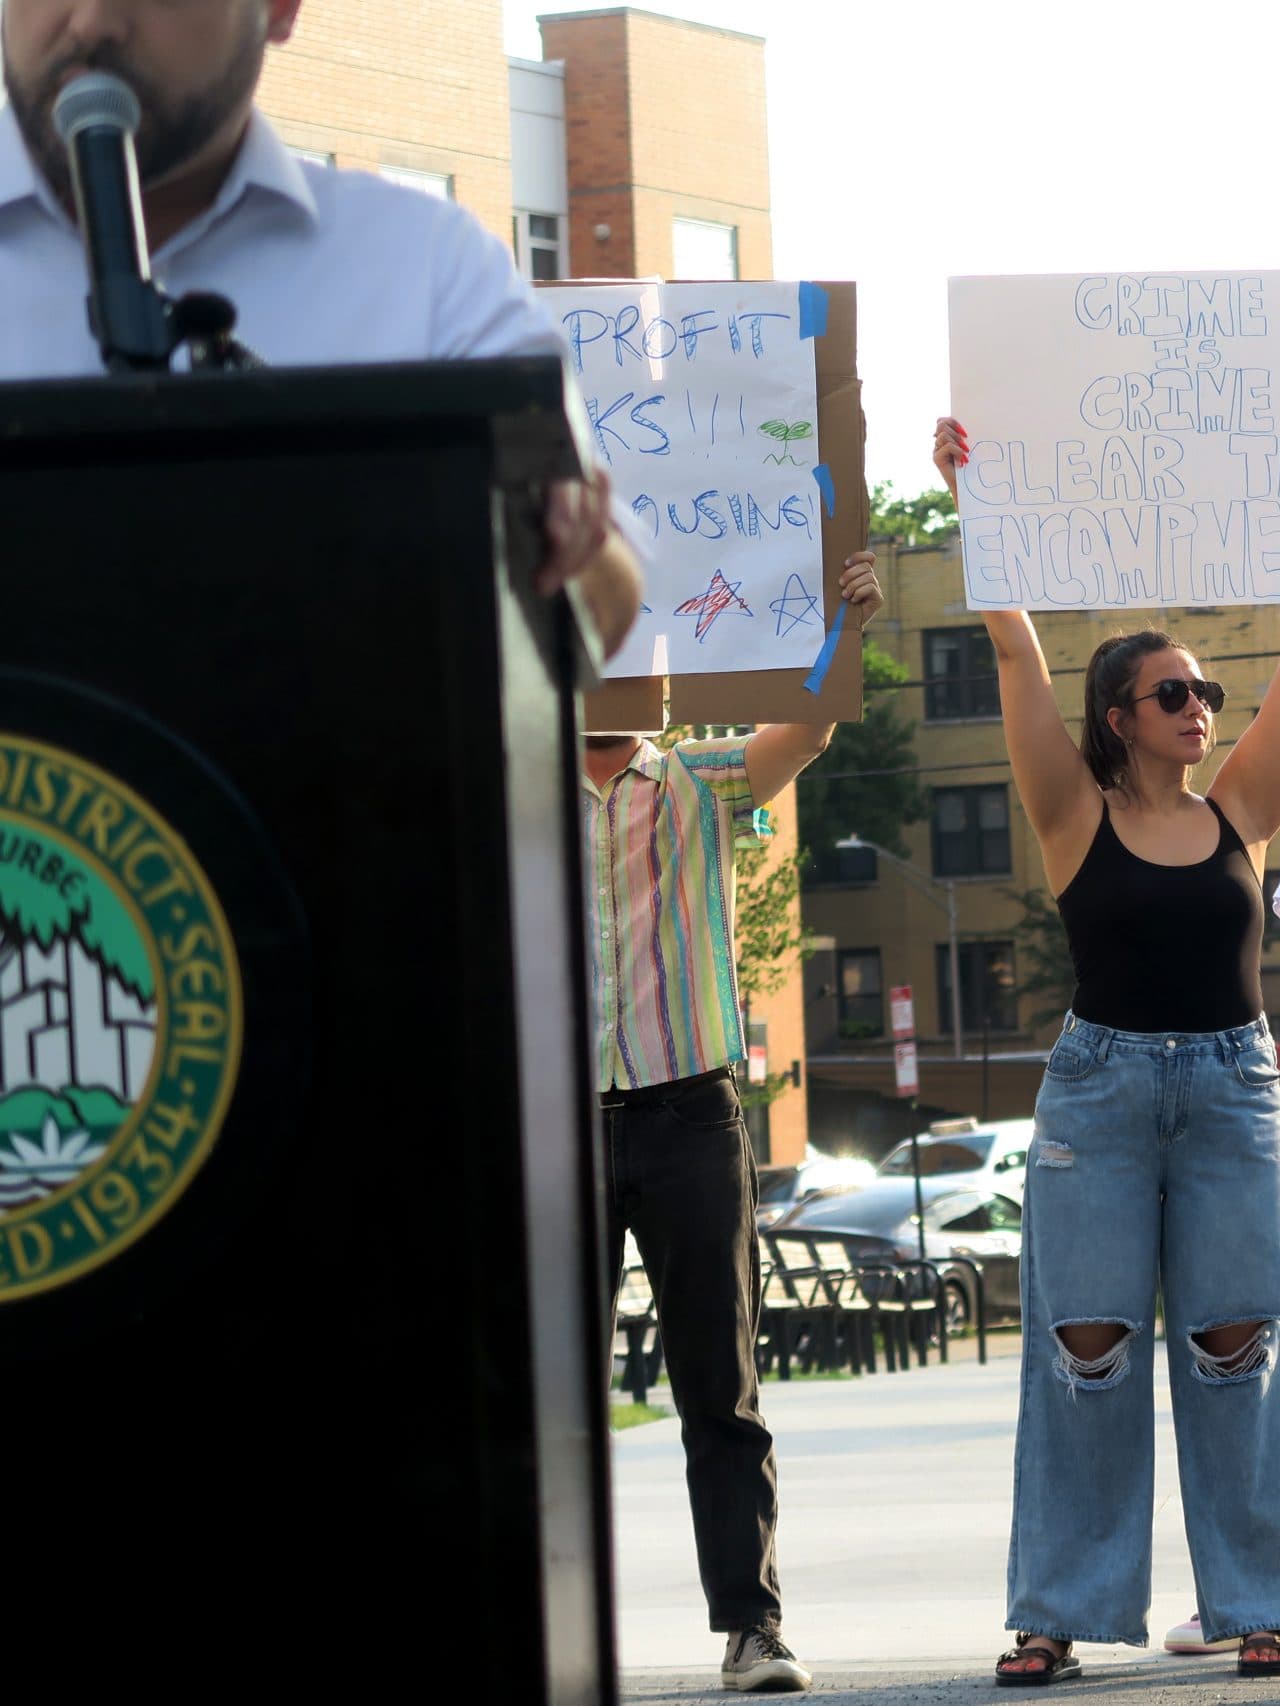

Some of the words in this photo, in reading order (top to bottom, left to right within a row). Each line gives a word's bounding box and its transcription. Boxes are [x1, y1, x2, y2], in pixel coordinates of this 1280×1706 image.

[563, 305, 790, 376] PROFIT
[1075, 276, 1267, 337] CRIME
[1153, 339, 1222, 369] IS
[1080, 368, 1274, 433] CRIME
[964, 436, 1185, 505] CLEAR
[161, 923, 228, 1079] SEAL
[72, 1104, 199, 1243] 1934
